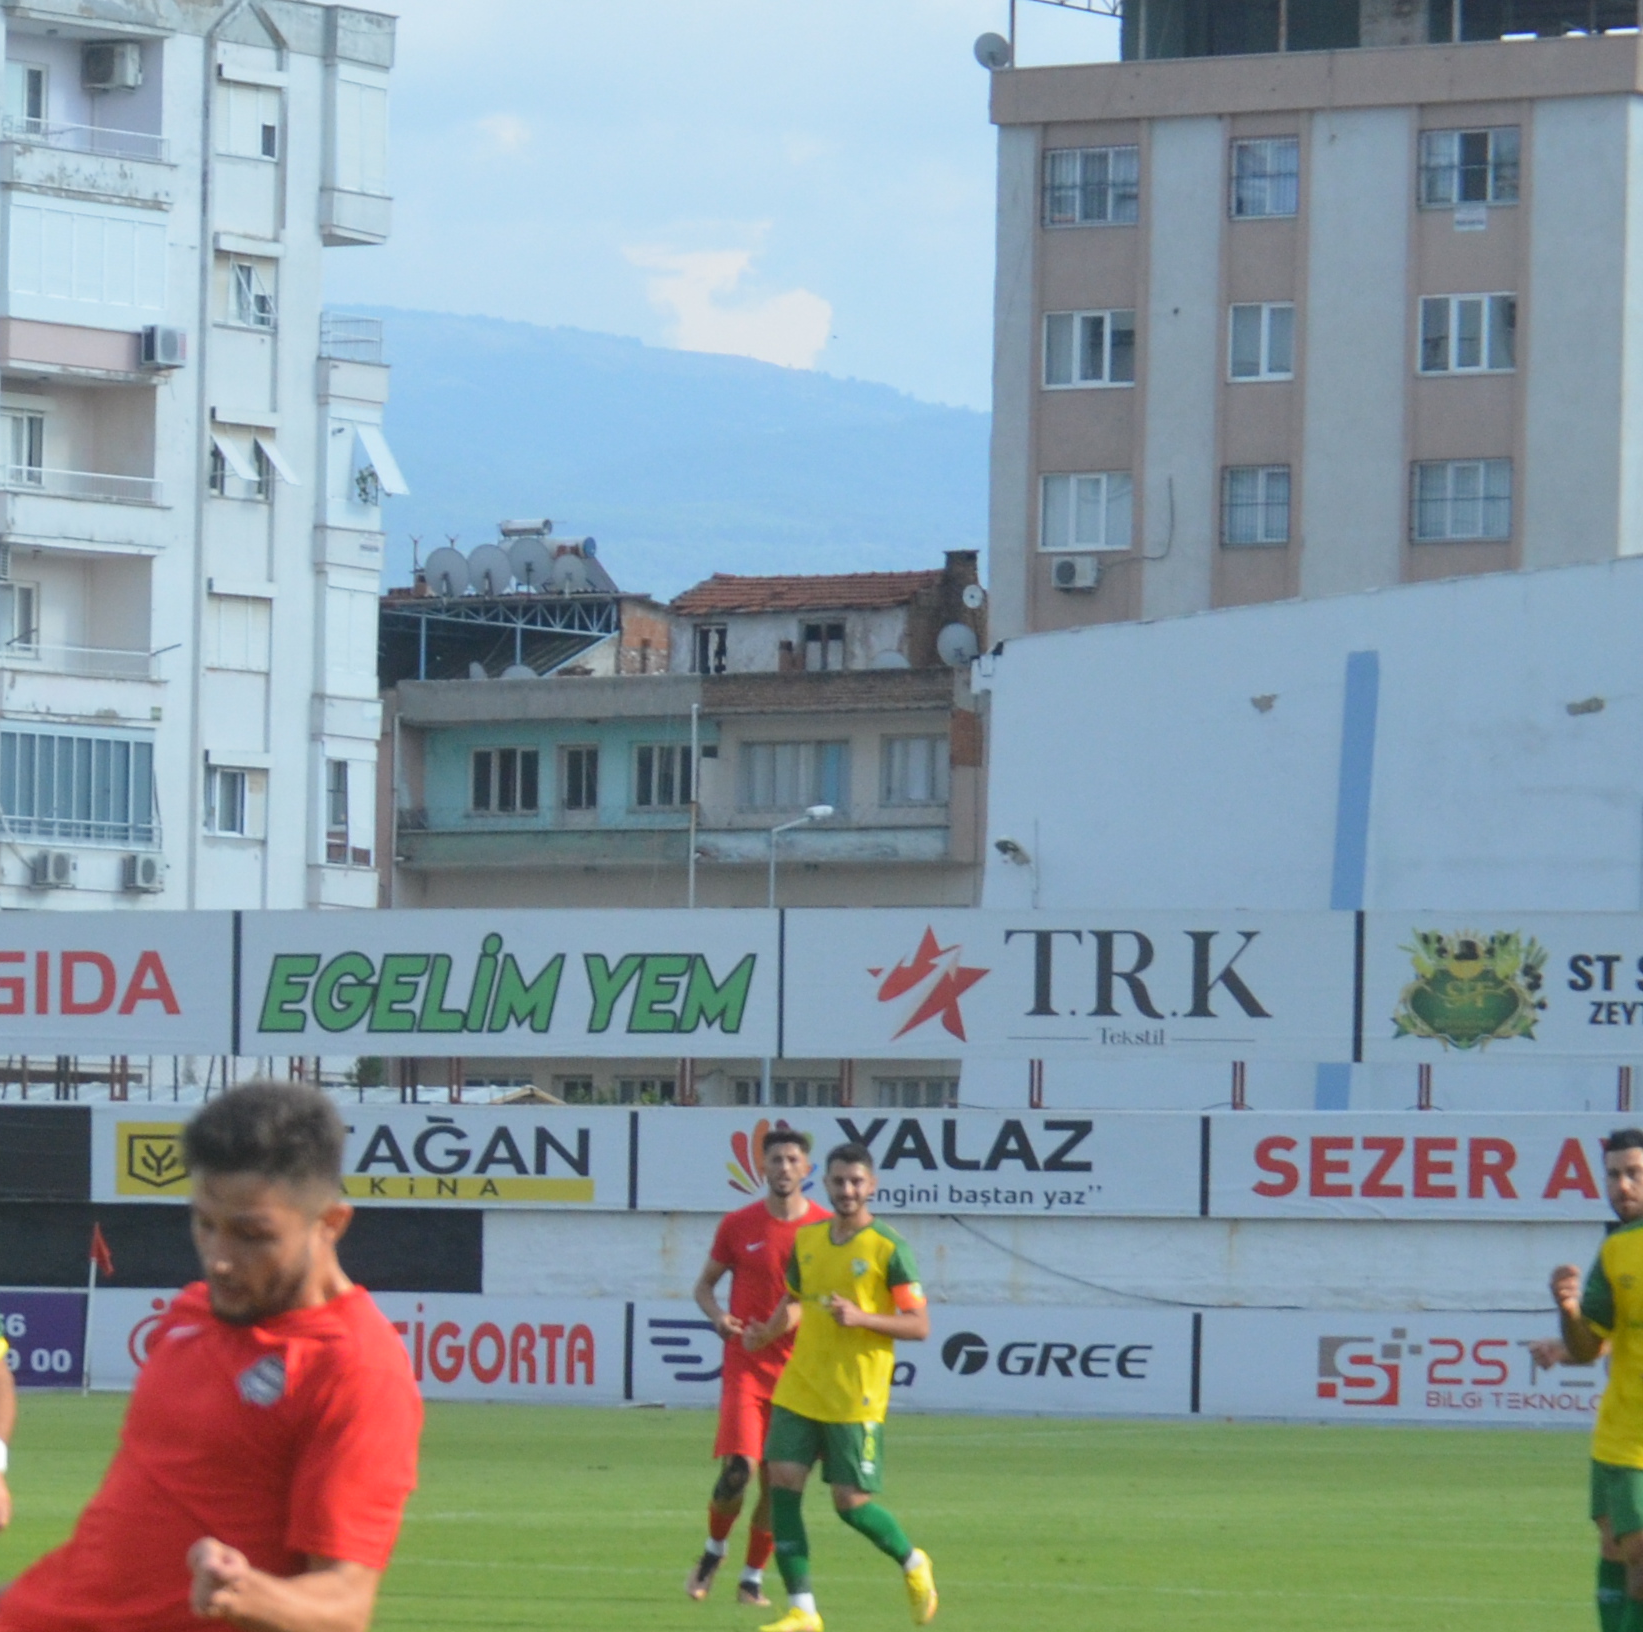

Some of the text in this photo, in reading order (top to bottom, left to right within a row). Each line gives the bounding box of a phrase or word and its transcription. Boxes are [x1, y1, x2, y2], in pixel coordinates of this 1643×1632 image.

[257, 932, 757, 1034] EGELİM YEM
[1004, 929, 1273, 1020] T.R.K
[1567, 954, 1621, 991] ST
[1096, 1027, 1164, 1046] Tekstil
[342, 1115, 591, 1177] AĞAN
[835, 1117, 1094, 1173] YALAZ
[1252, 1135, 1519, 1199] SEZER
[948, 1184, 1035, 1208] baştan
[30, 1348, 72, 1373] 00
[392, 1303, 595, 1385] İGORTA
[997, 1342, 1153, 1379] GREE
